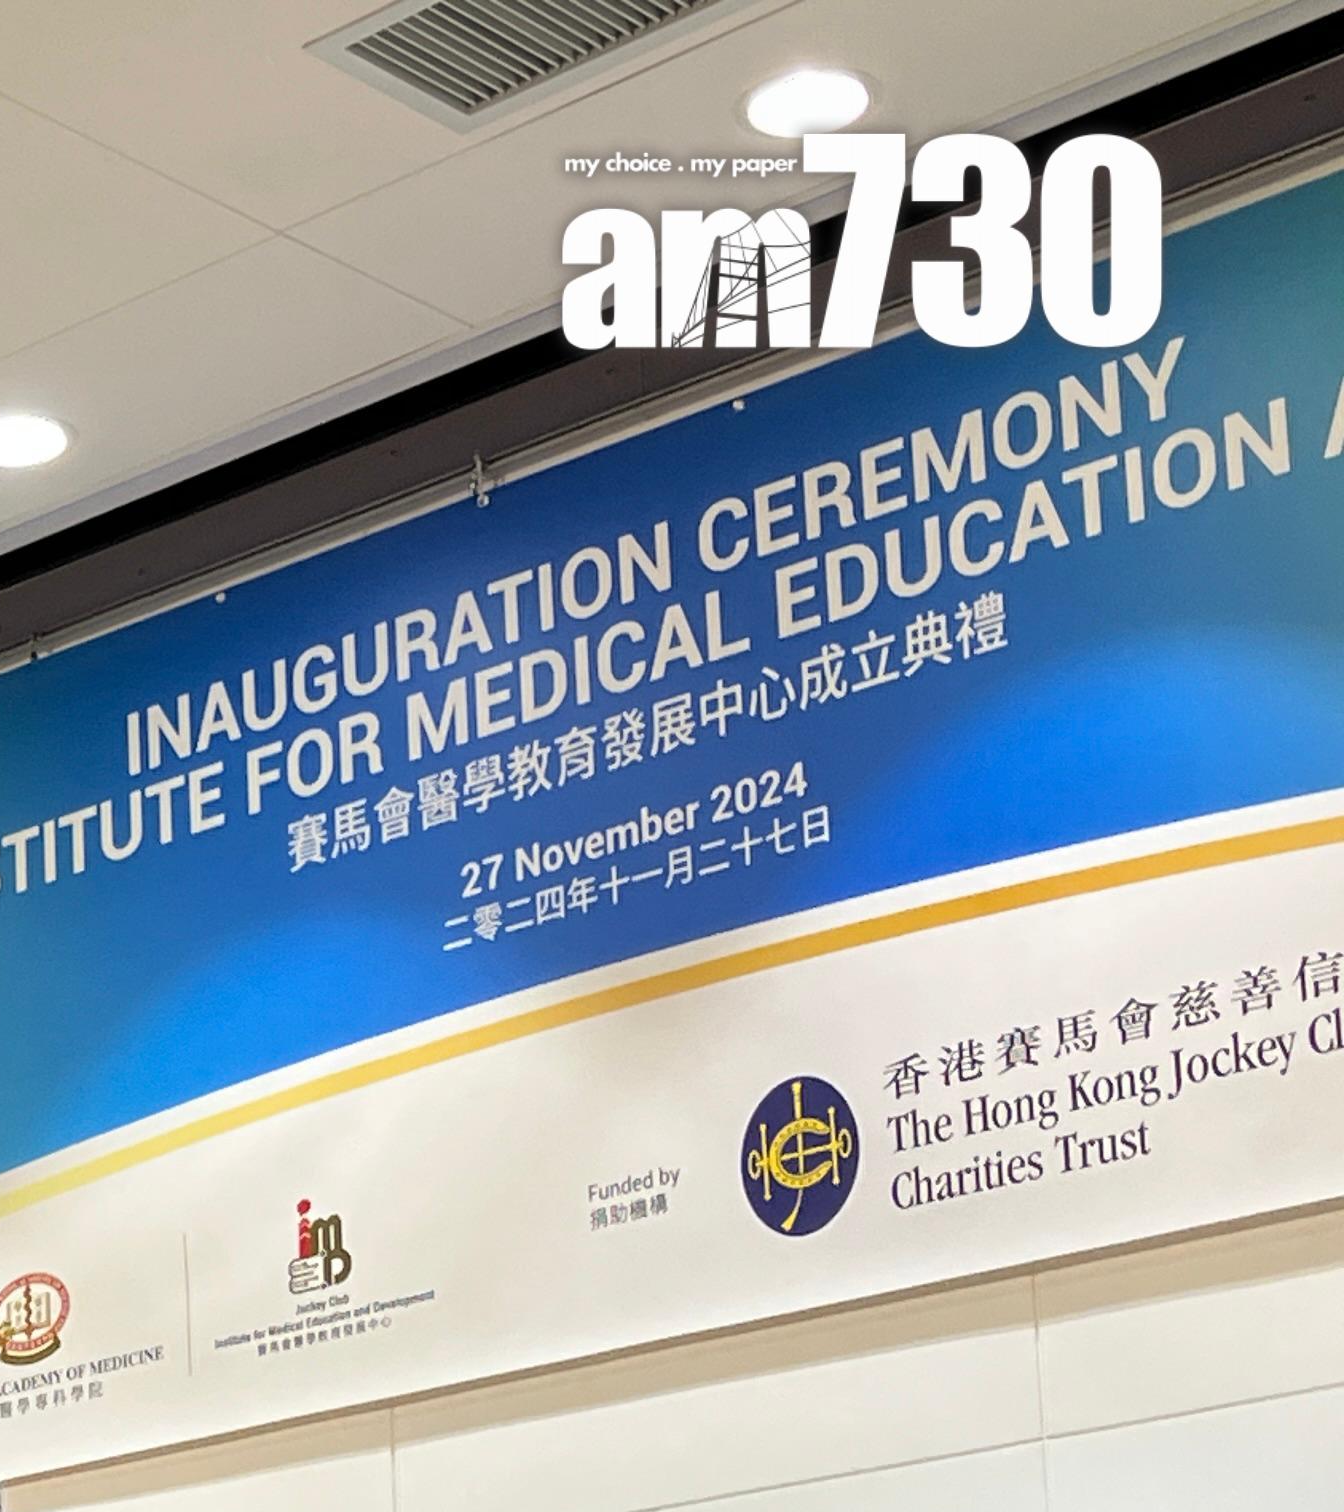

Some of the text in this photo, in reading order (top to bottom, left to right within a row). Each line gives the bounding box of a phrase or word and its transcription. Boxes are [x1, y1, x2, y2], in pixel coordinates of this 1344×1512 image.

[126, 336, 1186, 776] INAUGURATION CEREMONY
[246, 711, 384, 816] FOR
[408, 590, 752, 762] MEDICAL
[775, 396, 1291, 640] EDUCATION
[287, 591, 1009, 873] 賽馬會醫學教育發展中心成立典禮
[442, 804, 832, 952] 二零二四年十一月二十七日
[459, 760, 809, 899] 27 November 2024
[886, 1108, 954, 1153] The
[962, 1089, 1059, 1136] Hong
[1068, 1064, 1161, 1112] Kong
[1167, 1031, 1297, 1100] Jockey
[588, 1167, 681, 1202] Funded by
[891, 1121, 1151, 1210] Charities Trust
[65, 1363, 87, 1381] OF
[89, 1345, 166, 1375] MEDICINE
